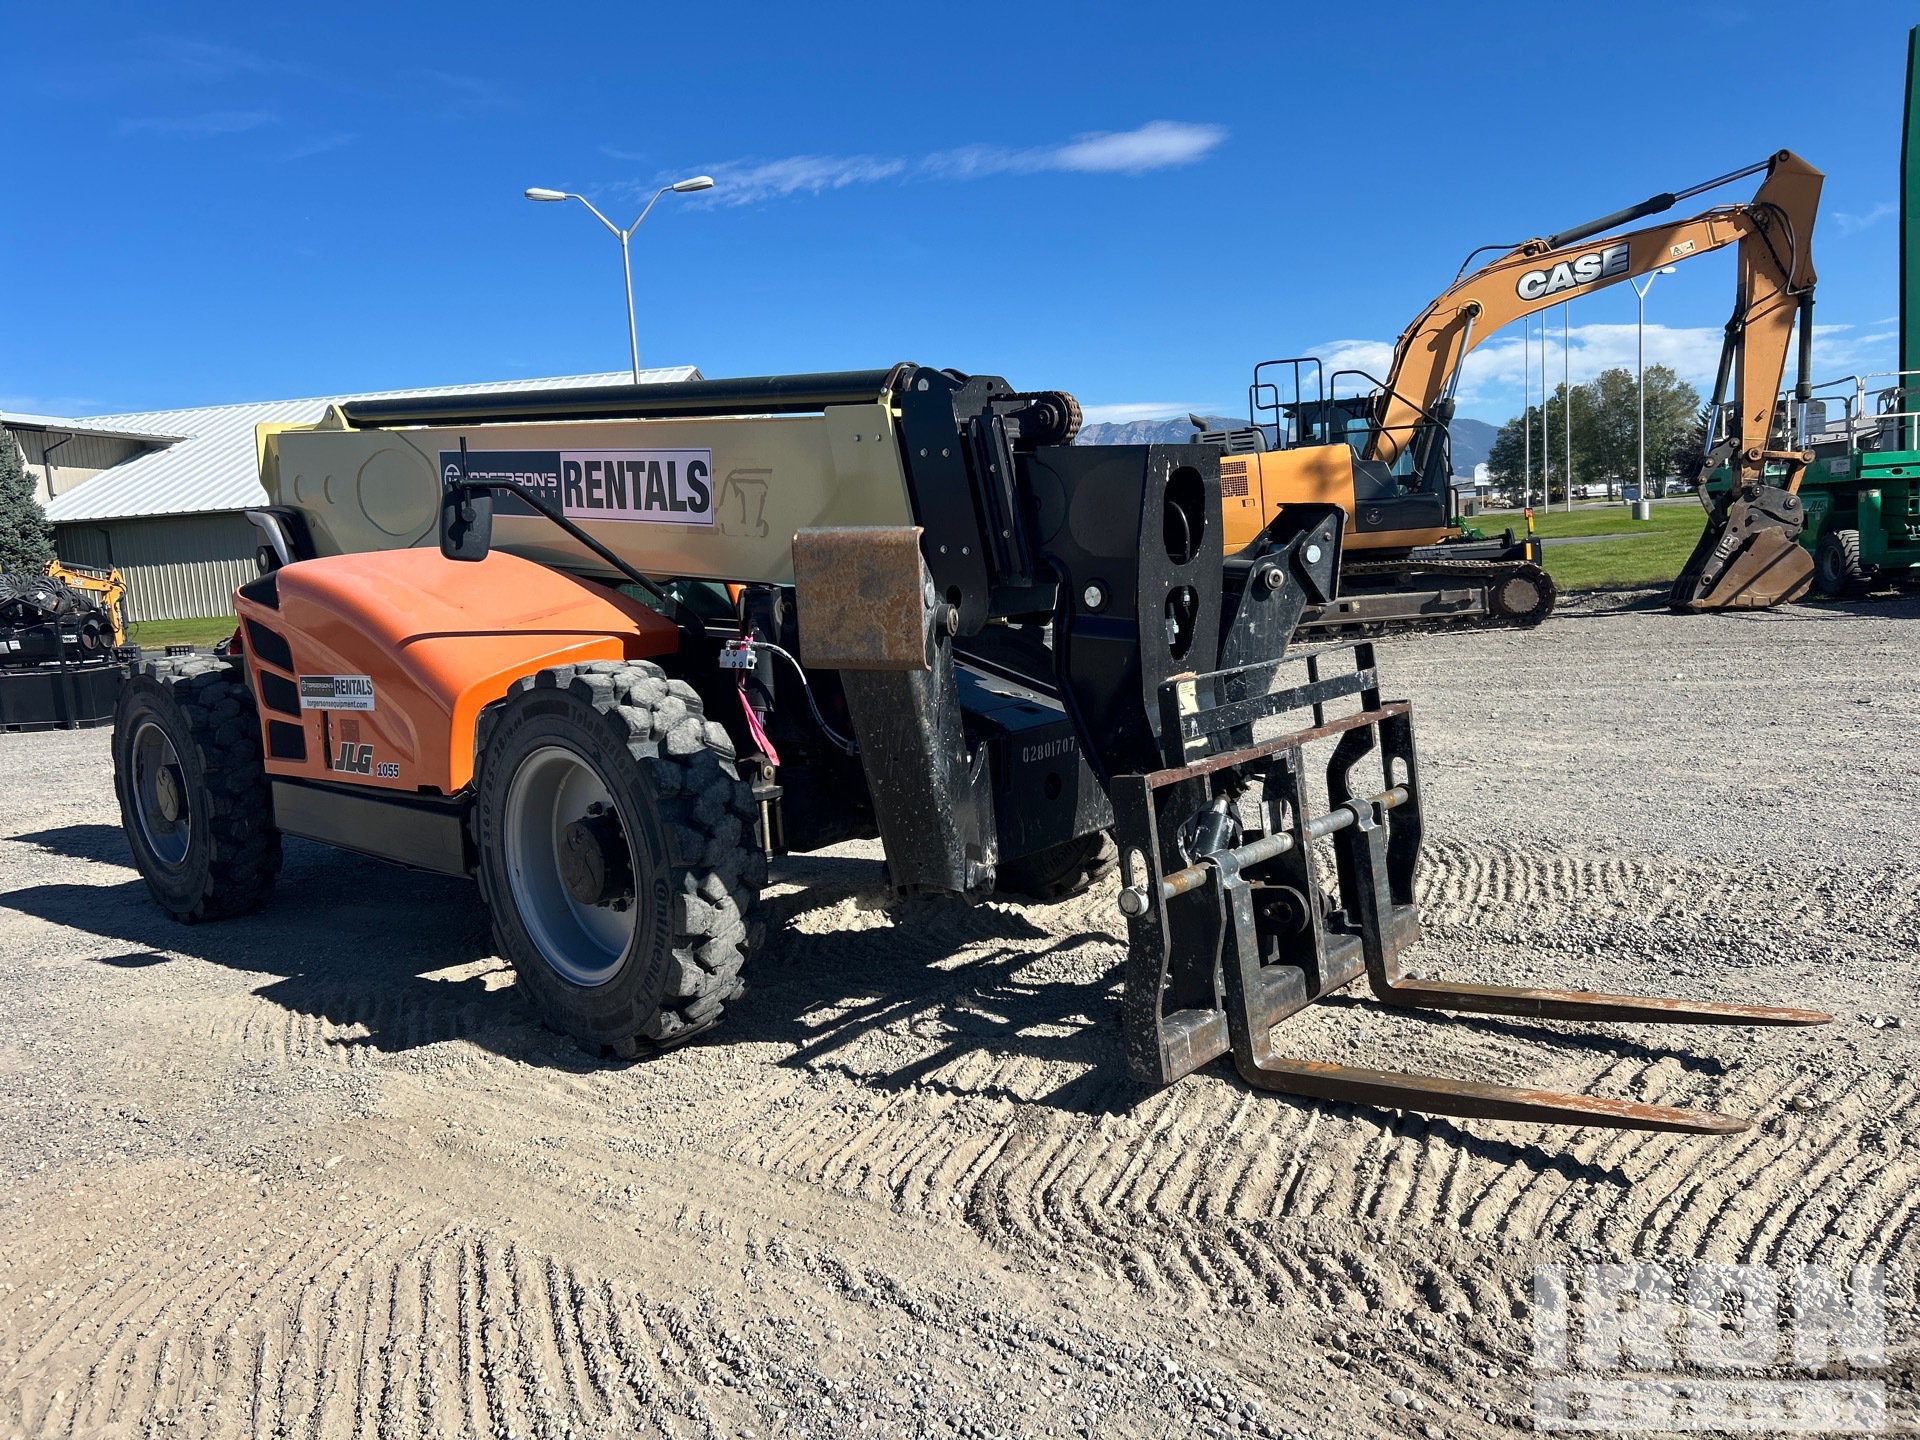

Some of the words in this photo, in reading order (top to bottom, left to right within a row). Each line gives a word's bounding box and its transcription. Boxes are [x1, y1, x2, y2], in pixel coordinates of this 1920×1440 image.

[1516, 243, 1630, 300] CASE
[467, 471, 557, 487] RSON'S
[562, 459, 711, 514] RENTALS
[334, 679, 373, 695] RENTALS
[306, 699, 368, 708] torgersonsequipment.com
[333, 741, 374, 775] JLG
[1022, 735, 1076, 763] 02801707
[376, 761, 400, 779] 1055
